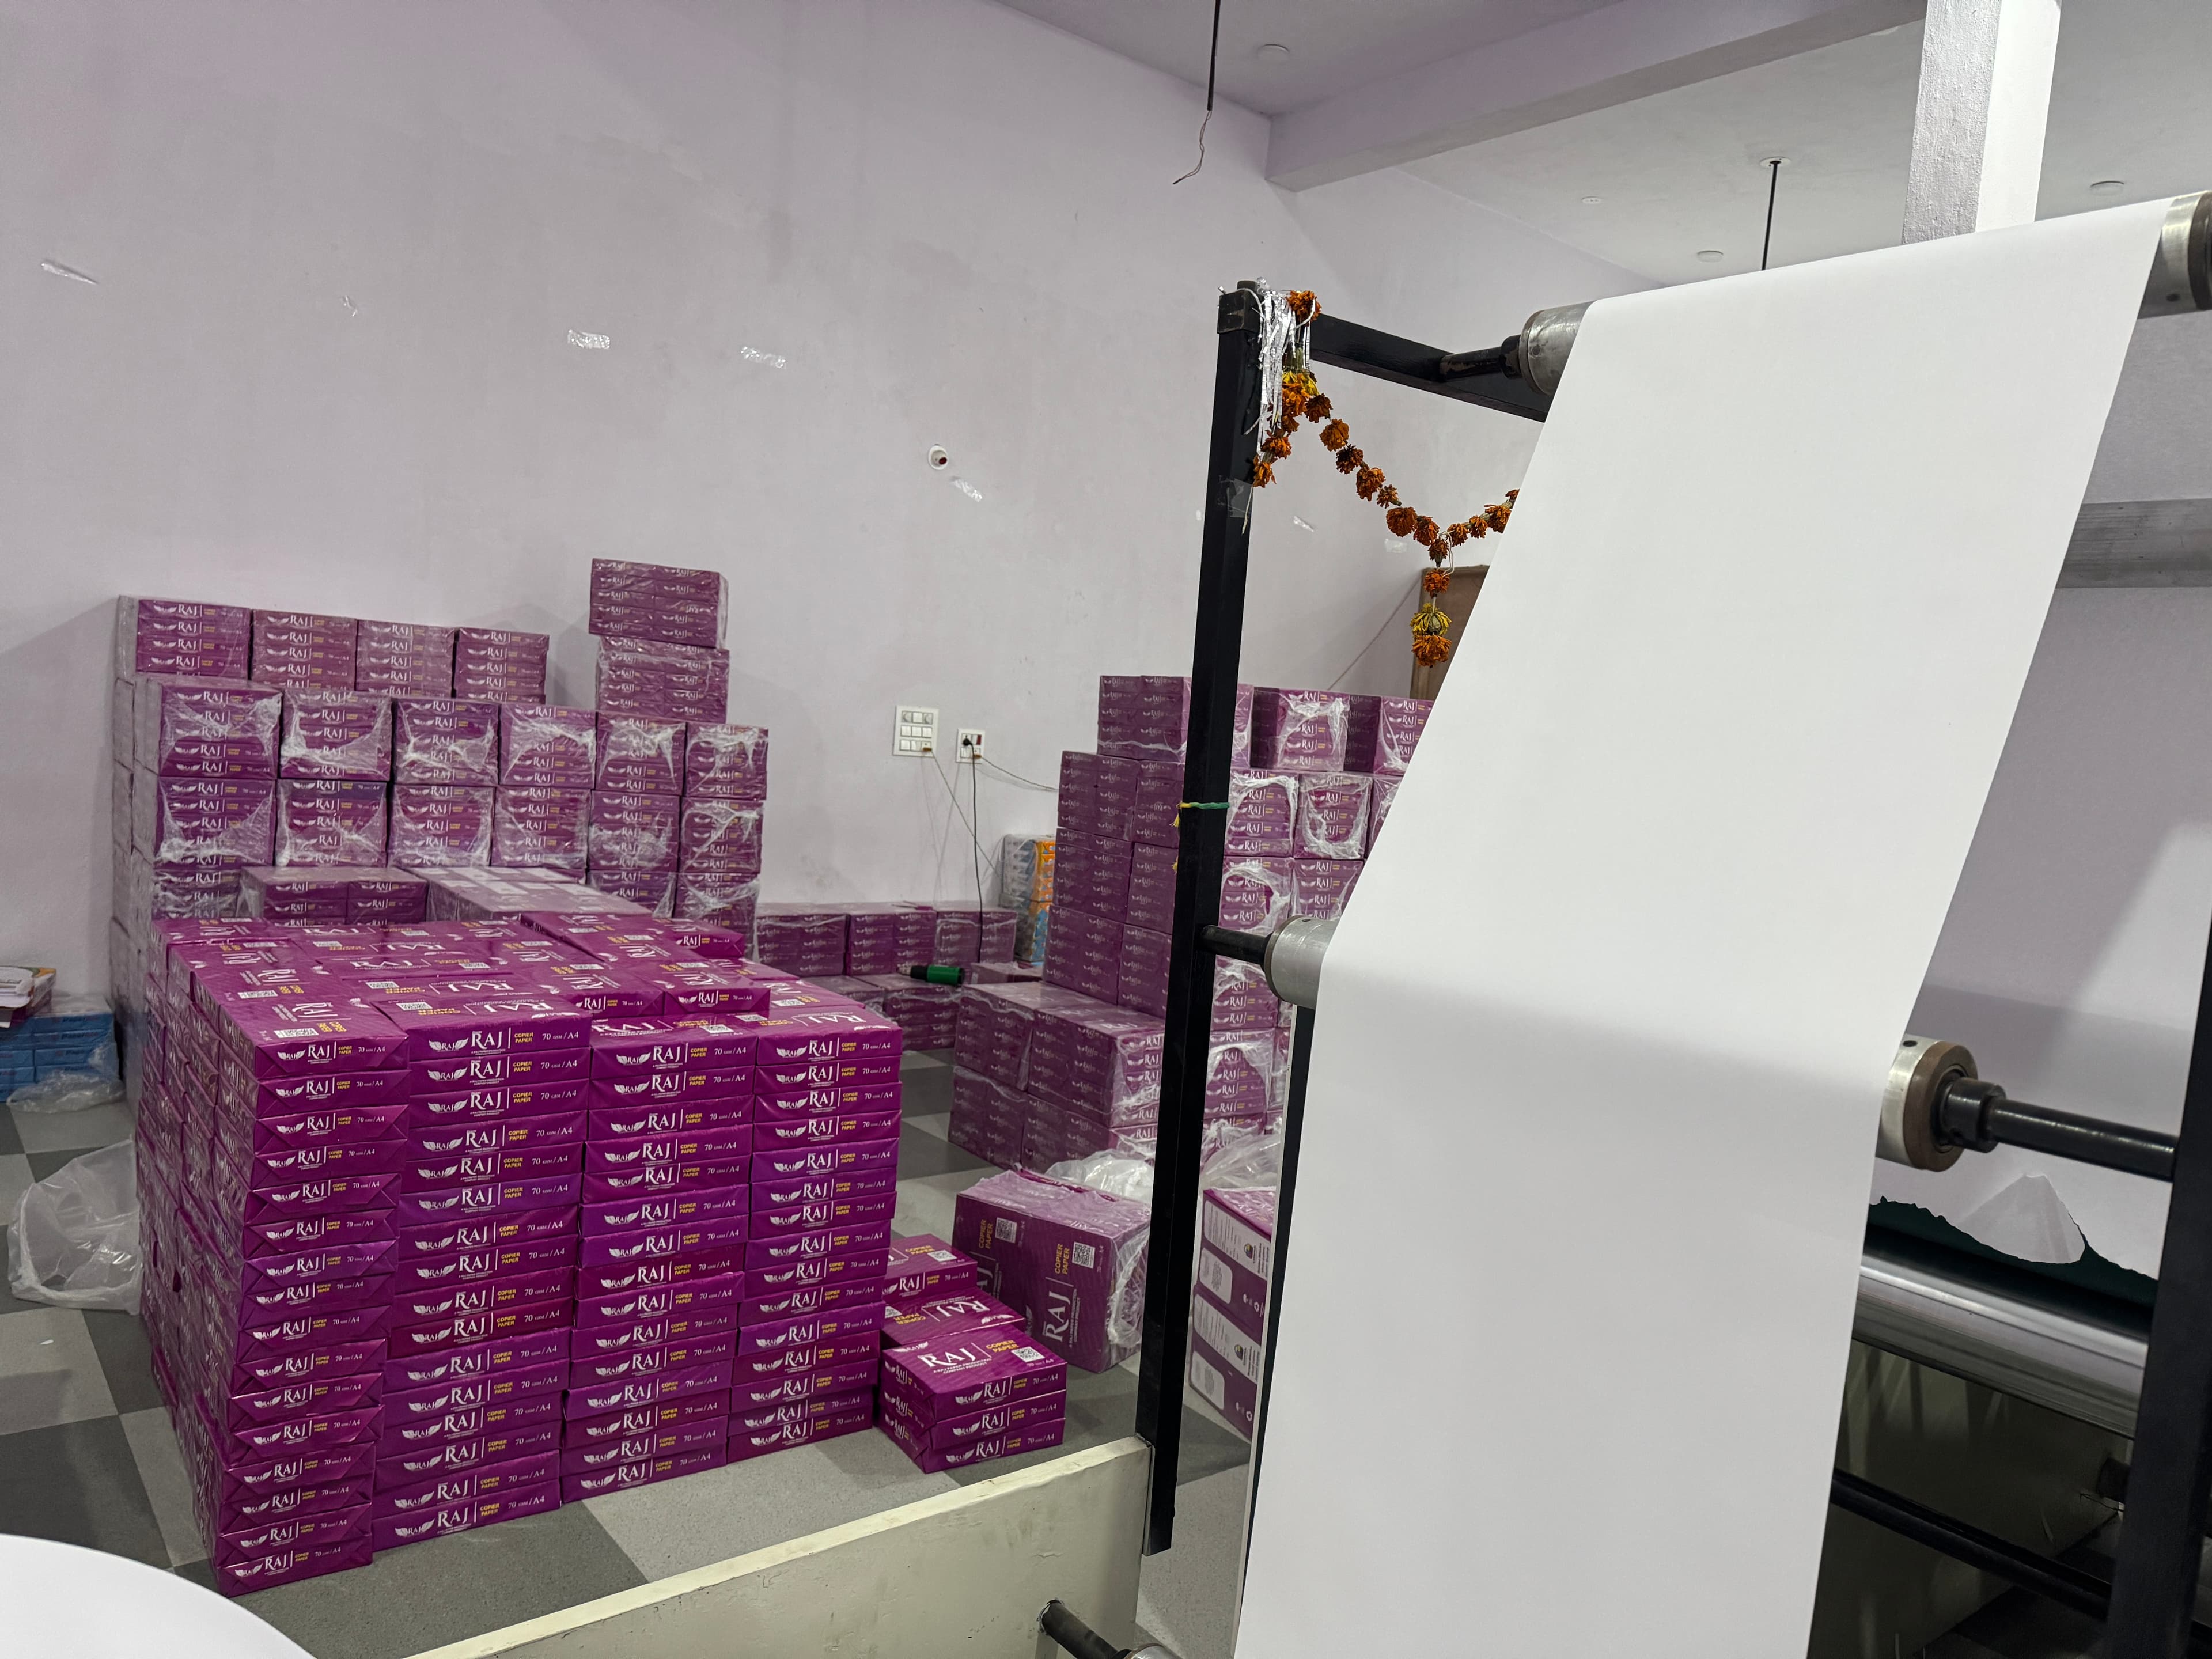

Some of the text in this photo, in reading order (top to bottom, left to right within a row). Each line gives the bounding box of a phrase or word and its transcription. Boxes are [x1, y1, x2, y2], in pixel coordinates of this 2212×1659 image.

[684, 935, 697, 946] RAJ
[584, 997, 602, 1010] RAJ
[699, 991, 715, 1005] RAJ
[441, 1042, 455, 1050] RAJ
[472, 1031, 502, 1049] RAJ
[809, 1041, 832, 1056] RAJ
[308, 1045, 329, 1059] RAJ
[653, 1046, 680, 1063] RAJ
[471, 1060, 501, 1078] RAJ
[809, 1066, 832, 1081] RAJ
[307, 1081, 328, 1094] RAJ
[652, 1075, 679, 1092] RAJ
[471, 1092, 501, 1109] RAJ
[810, 1091, 834, 1107] RAJ
[308, 1116, 329, 1130] RAJ
[648, 1113, 675, 1130] RAJ
[809, 1119, 832, 1135] RAJ
[466, 1130, 496, 1147] RAJ
[298, 1150, 320, 1164] RAJ
[642, 1143, 670, 1160] RAJ
[461, 1158, 492, 1175] RAJ
[807, 1153, 831, 1169] RAJ
[646, 1167, 672, 1184] RAJ
[303, 1183, 324, 1198] RAJ
[462, 1188, 492, 1206] RAJ
[804, 1183, 827, 1199] RAJ
[642, 1203, 668, 1221] RAJ
[803, 1205, 827, 1222] RAJ
[297, 1221, 317, 1236] RAJ
[457, 1226, 487, 1245] RAJ
[985, 1223, 993, 1249] PAPER
[646, 1235, 673, 1252] RAJ
[801, 1236, 825, 1253] RAJ
[297, 1257, 319, 1271] RAJ
[460, 1254, 489, 1272] RAJ
[1055, 1244, 1063, 1274] COPIER
[638, 1266, 664, 1283] RAJ
[796, 1263, 820, 1278] RAJ
[287, 1285, 308, 1299] RAJ
[900, 1276, 919, 1291] RAJ
[455, 1290, 486, 1309] RAJ
[638, 1294, 665, 1312] RAJ
[792, 1291, 816, 1308] RAJ
[936, 1300, 990, 1317] RAJ
[1046, 1291, 1070, 1342] RAJ
[283, 1320, 305, 1335] RAJ
[454, 1317, 484, 1336] RAJ
[633, 1324, 660, 1342] RAJ
[789, 1324, 812, 1342] RAJ
[986, 1340, 1016, 1349] COPIER
[993, 1344, 1019, 1353] PAPER
[286, 1357, 307, 1372] RAJ
[450, 1354, 481, 1373] RAJ
[632, 1352, 659, 1370] RAJ
[785, 1350, 809, 1366] RAJ
[918, 1347, 976, 1367] RAJ
[451, 1385, 482, 1404] RAJ
[624, 1384, 651, 1401] RAJ
[783, 1378, 808, 1395] RAJ
[984, 1381, 1006, 1397] RAJ
[284, 1388, 306, 1403] RAJ
[624, 1411, 650, 1429] RAJ
[777, 1404, 800, 1421] RAJ
[982, 1412, 1003, 1429] RAJ
[445, 1412, 475, 1432] RAJ
[783, 1422, 806, 1439] RAJ
[284, 1424, 305, 1438] RAJ
[445, 1443, 476, 1462] RAJ
[622, 1438, 649, 1456] RAJ
[976, 1441, 999, 1457] RAJ
[274, 1462, 296, 1477] RAJ
[618, 1463, 645, 1482] RAJ
[438, 1480, 468, 1499] RAJ
[272, 1493, 293, 1508] RAJ
[438, 1508, 468, 1528] RAJ
[270, 1526, 292, 1541] RAJ
[265, 1555, 286, 1570] RAJ
